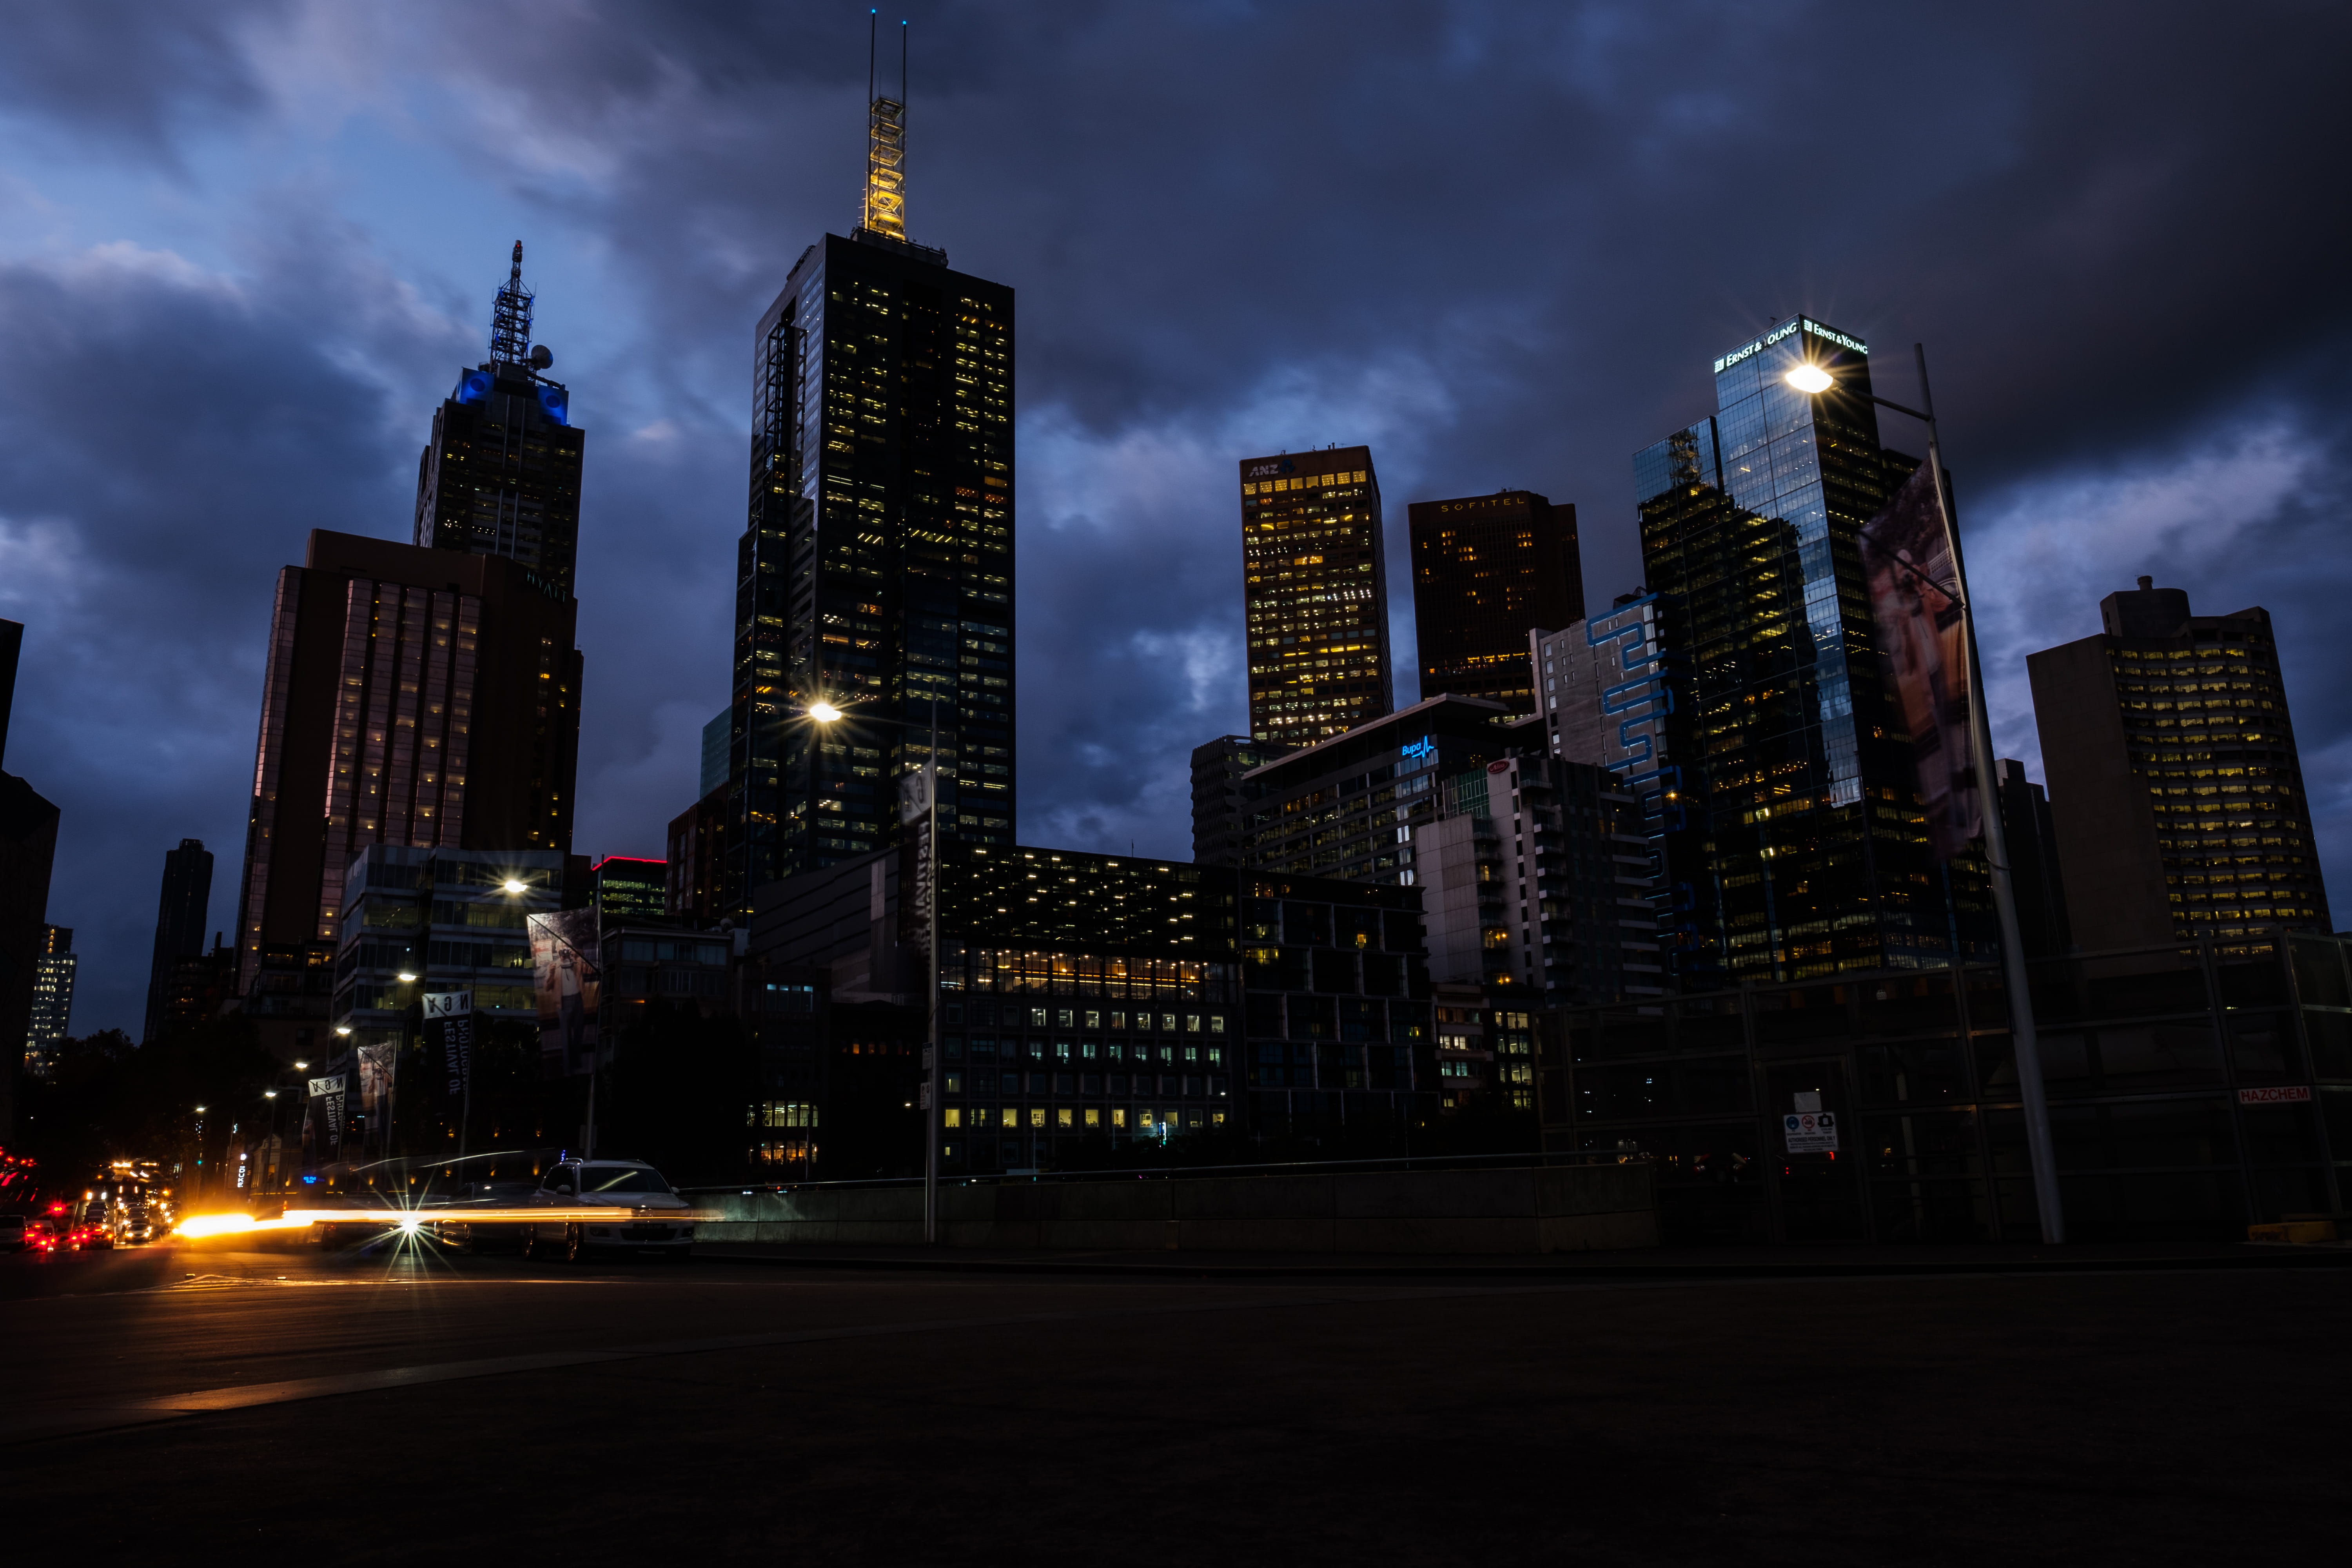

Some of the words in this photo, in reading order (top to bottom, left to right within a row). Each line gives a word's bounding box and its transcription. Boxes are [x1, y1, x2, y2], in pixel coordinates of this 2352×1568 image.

[1814, 323, 1835, 342] ERNST
[1836, 335, 1842, 344] &
[1841, 335, 1868, 354] YOUNG
[1727, 344, 1754, 367] ERNST
[1755, 341, 1762, 352] &
[1249, 464, 1278, 477] ANZ
[1441, 497, 1524, 512] SOFITEL
[526, 570, 568, 603] HYATT
[1402, 742, 1421, 756] Bupa
[2241, 1087, 2308, 1102] HAZCHEM
